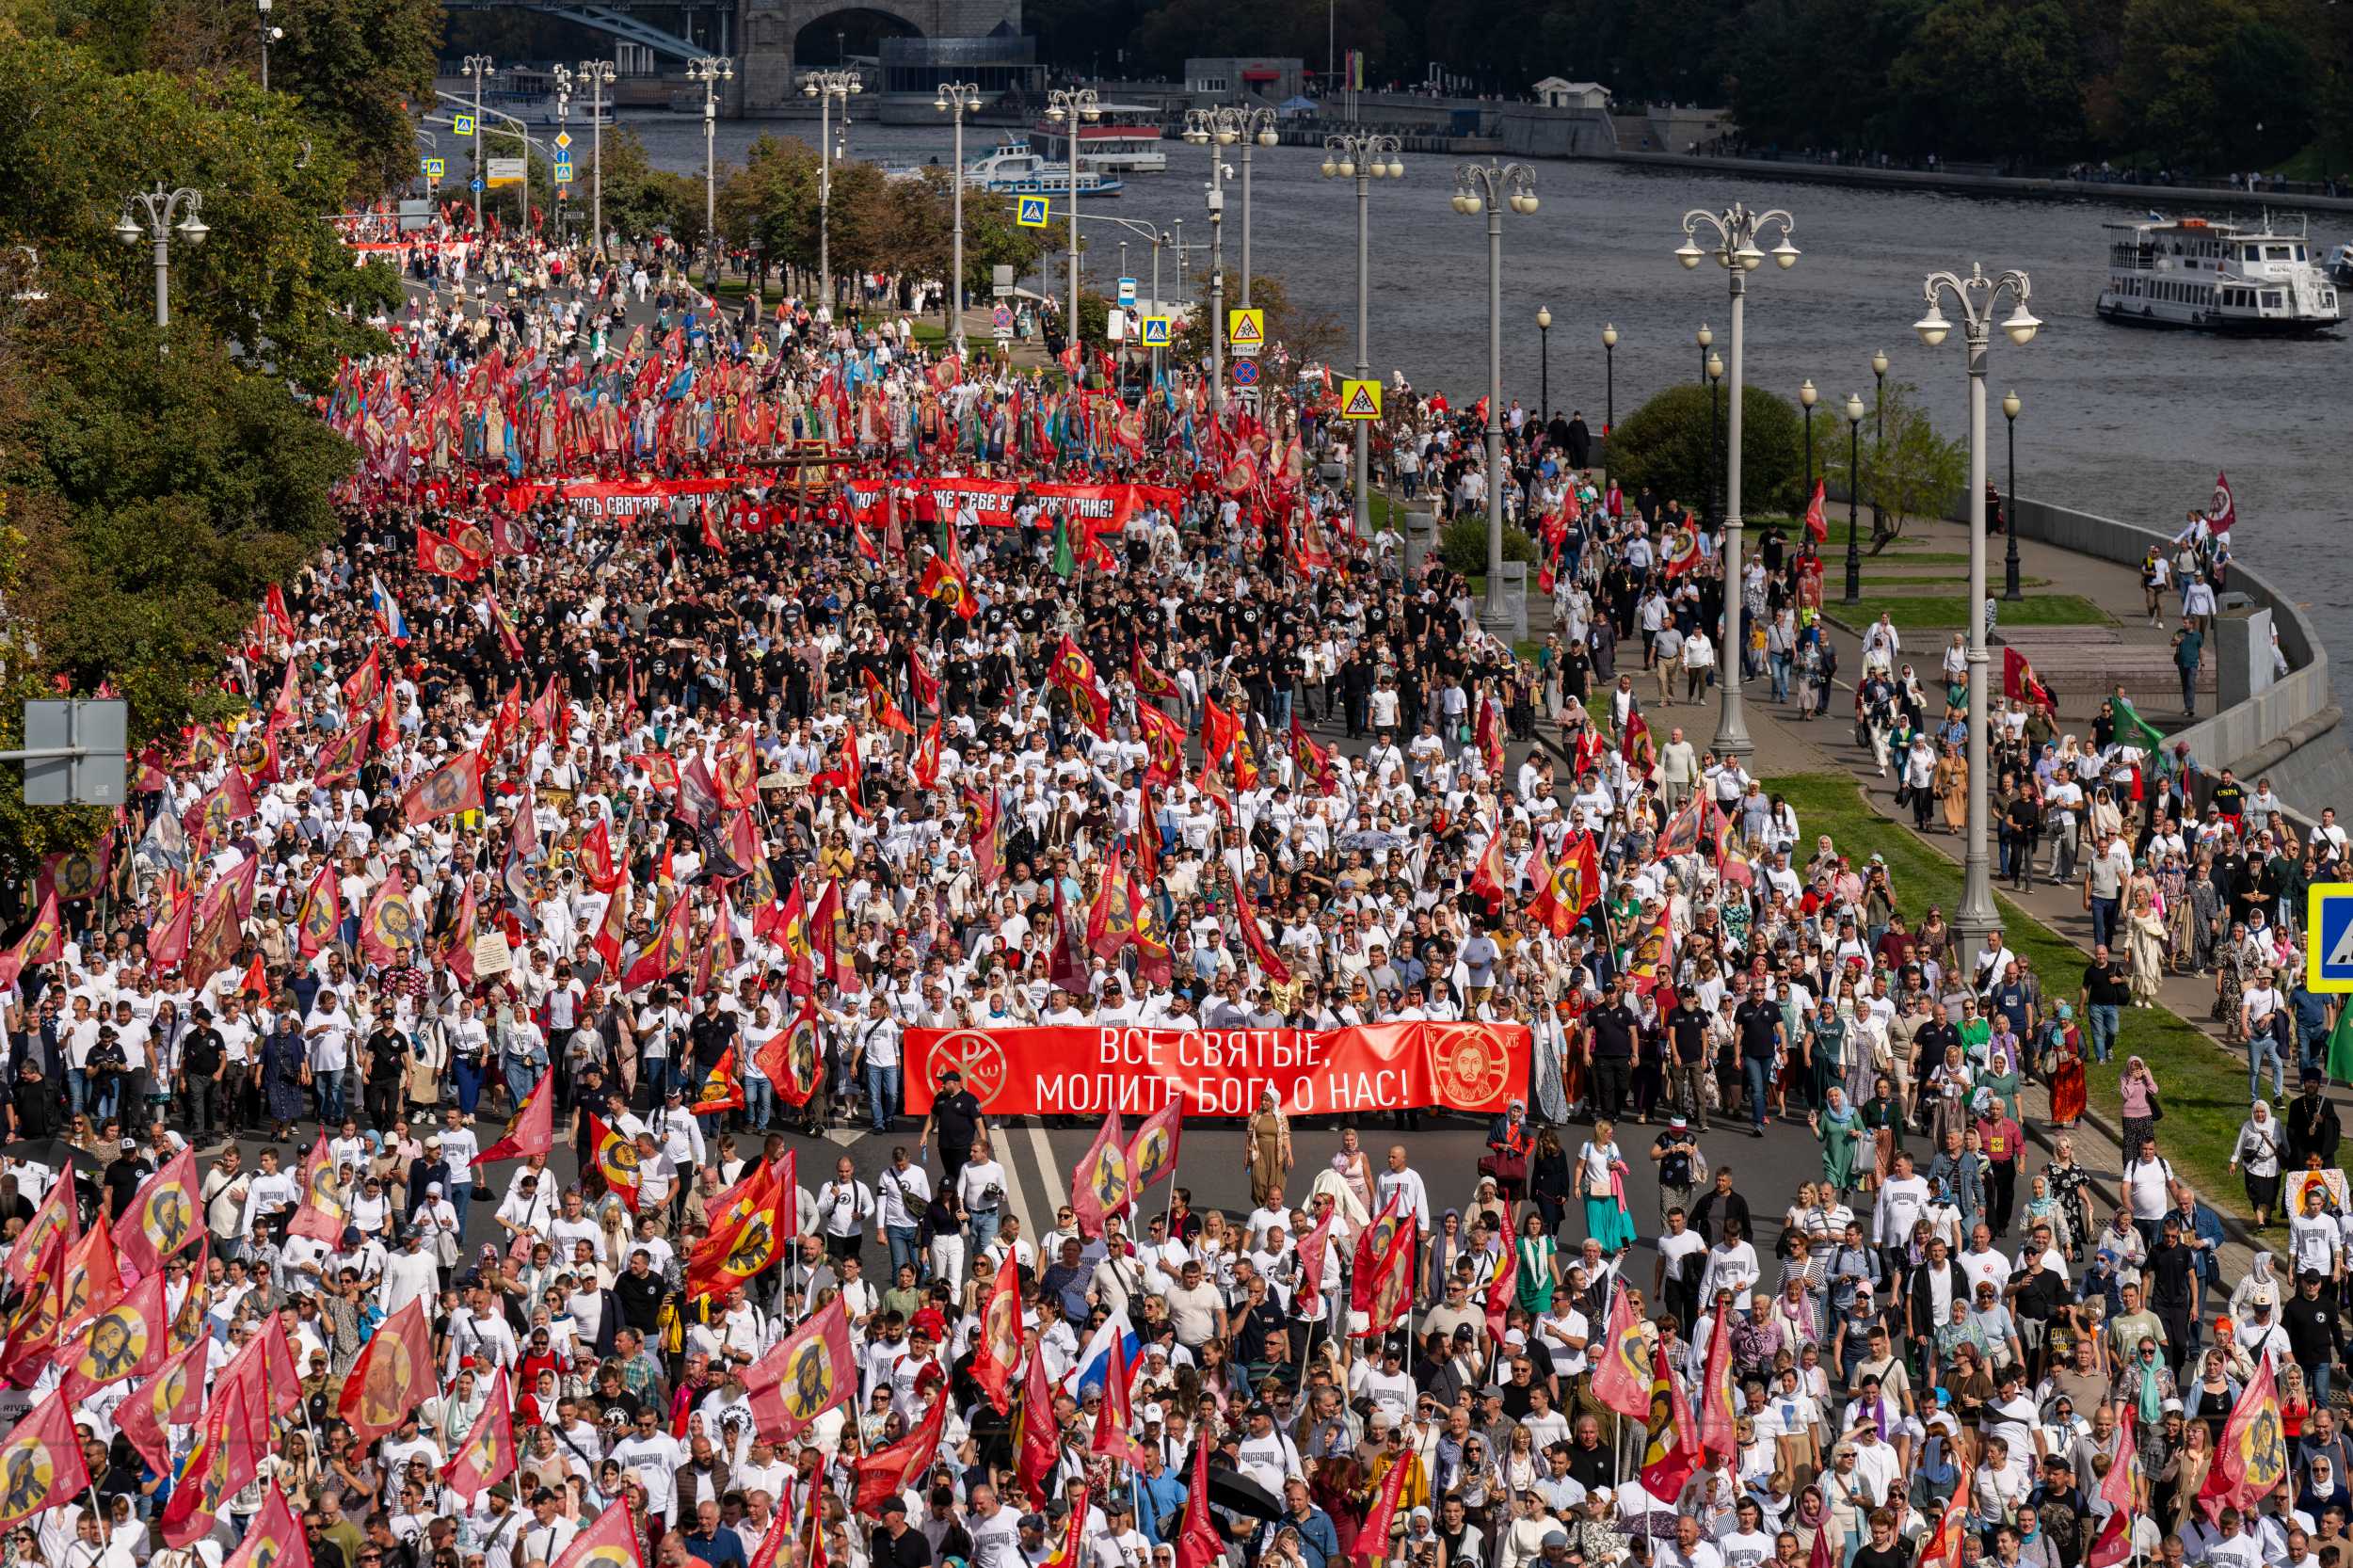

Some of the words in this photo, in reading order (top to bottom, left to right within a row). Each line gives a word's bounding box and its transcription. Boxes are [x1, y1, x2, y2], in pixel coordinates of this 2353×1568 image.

[568, 497, 602, 516] УСЬ
[1100, 1027, 1164, 1066] ВСЕ
[1179, 1031, 1331, 1069] СВЯТЫЕ,
[1036, 1073, 1182, 1112] МОЛИТЕ
[1198, 1076, 1274, 1114] БОГ
[1293, 1076, 1314, 1112] О
[1331, 1069, 1409, 1110] НАС!
